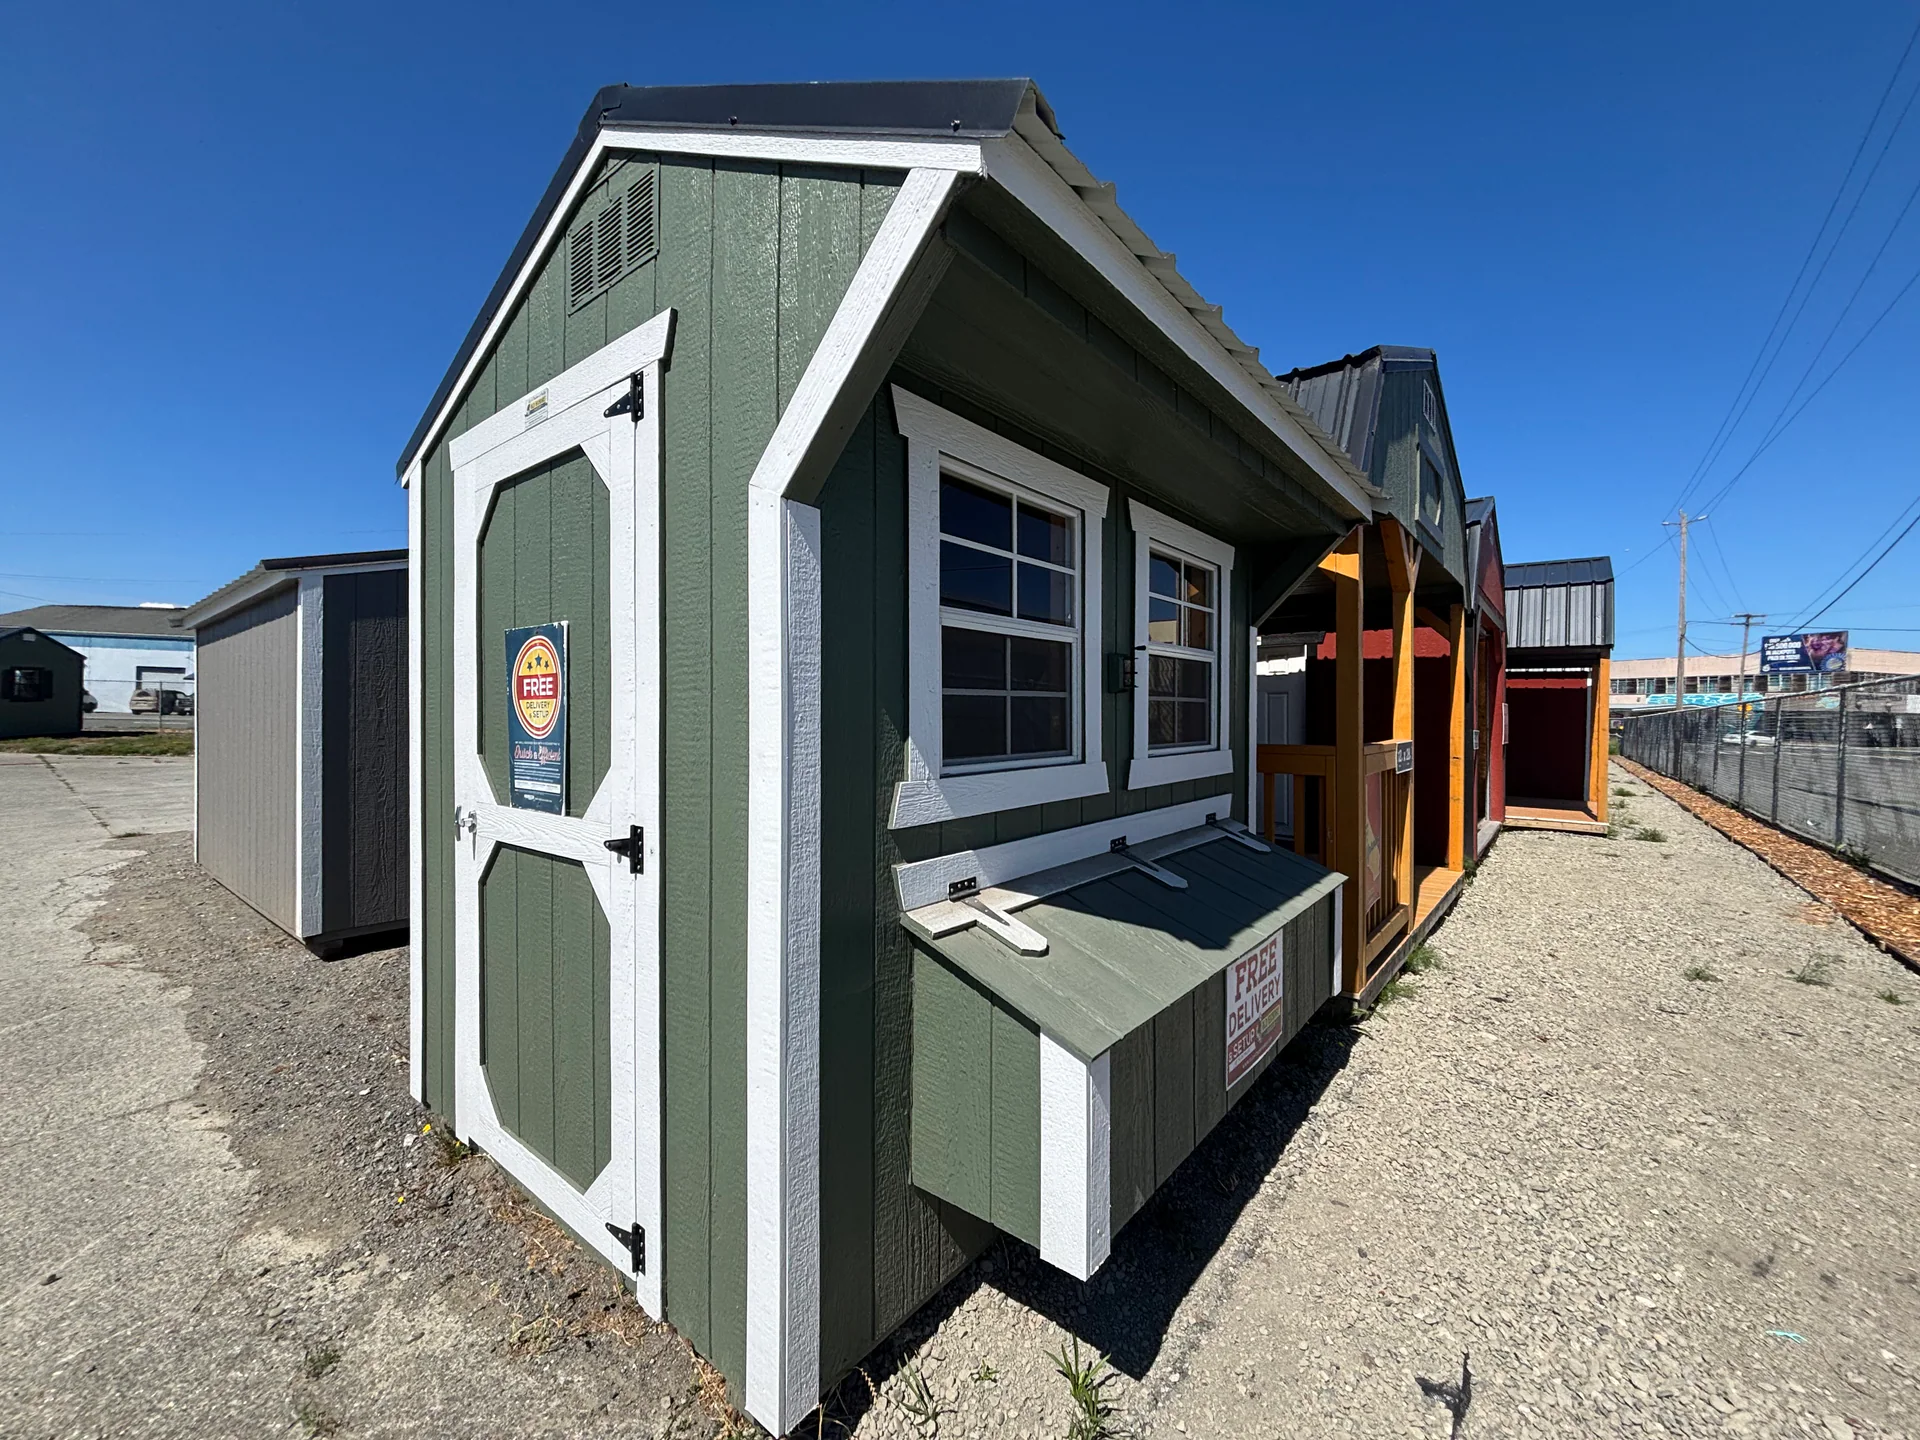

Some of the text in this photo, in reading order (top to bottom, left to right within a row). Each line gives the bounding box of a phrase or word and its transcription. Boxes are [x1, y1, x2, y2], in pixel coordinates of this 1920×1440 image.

[523, 677, 553, 697] FREE
[526, 701, 551, 710] DELIVERY
[533, 710, 550, 719] SETUP
[1235, 938, 1277, 1003] FREE
[1229, 973, 1281, 1038] DELIVERY
[1233, 1028, 1255, 1059] SETUP
